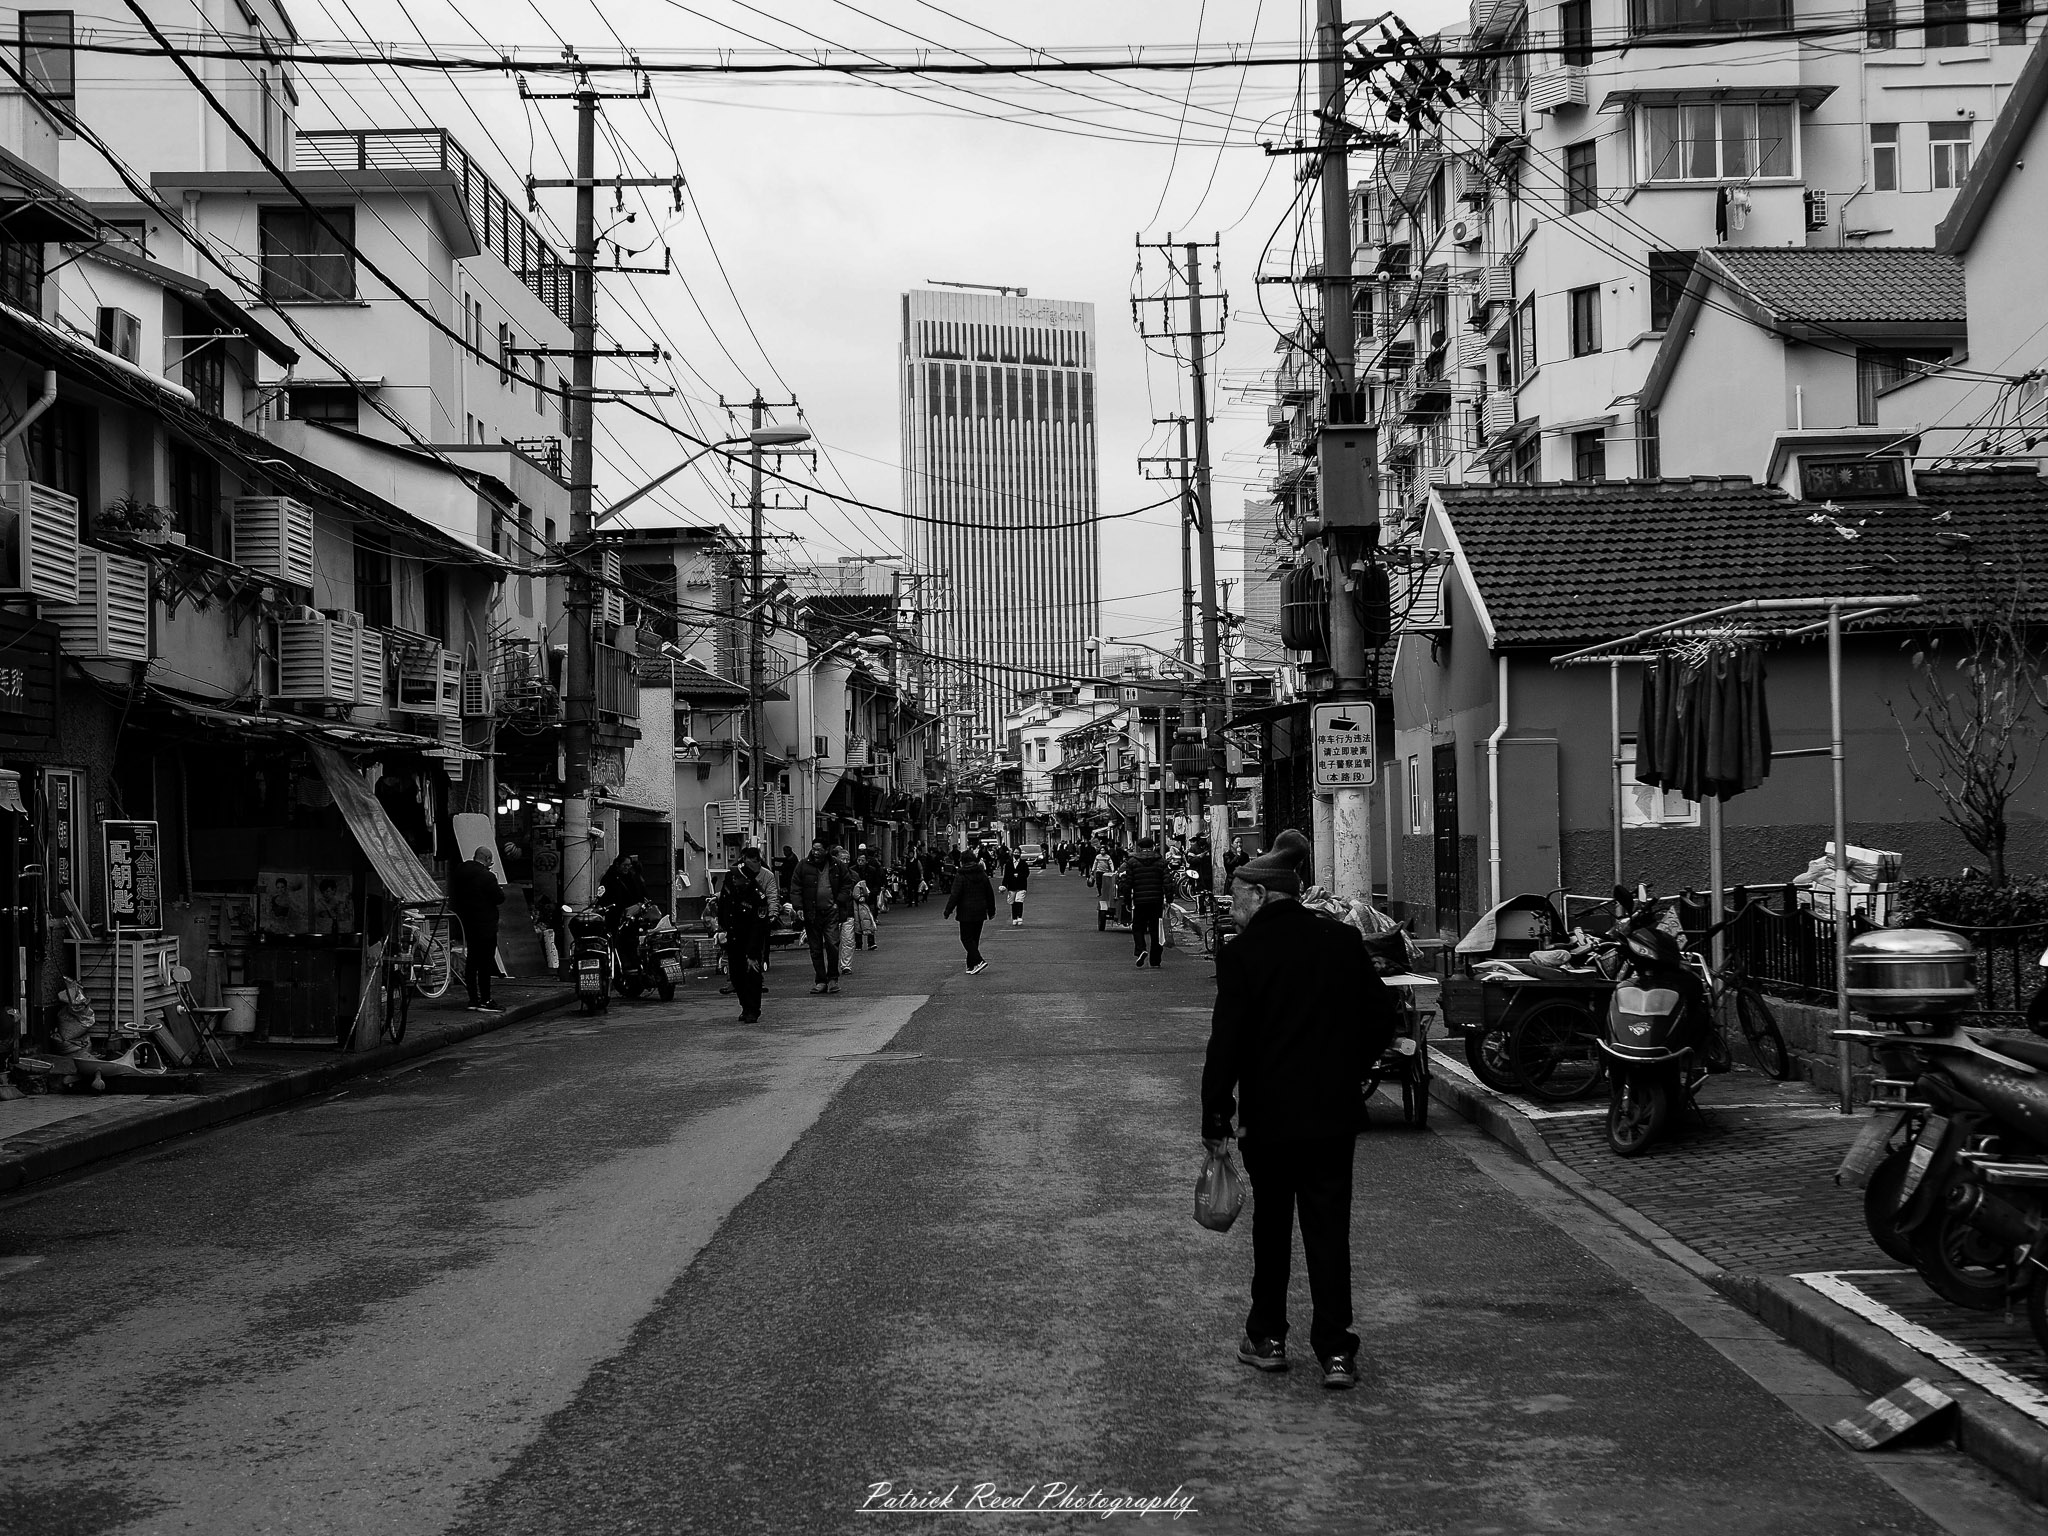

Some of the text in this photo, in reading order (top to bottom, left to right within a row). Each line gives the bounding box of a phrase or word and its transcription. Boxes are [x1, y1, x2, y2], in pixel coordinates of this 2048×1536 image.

[1318, 734, 1371, 745] 停车行为违法
[1323, 746, 1368, 757] 请立即驶离
[1319, 758, 1371, 769] 电子警察监管
[109, 840, 134, 914] 配钥匙
[134, 828, 157, 925] 五金建材
